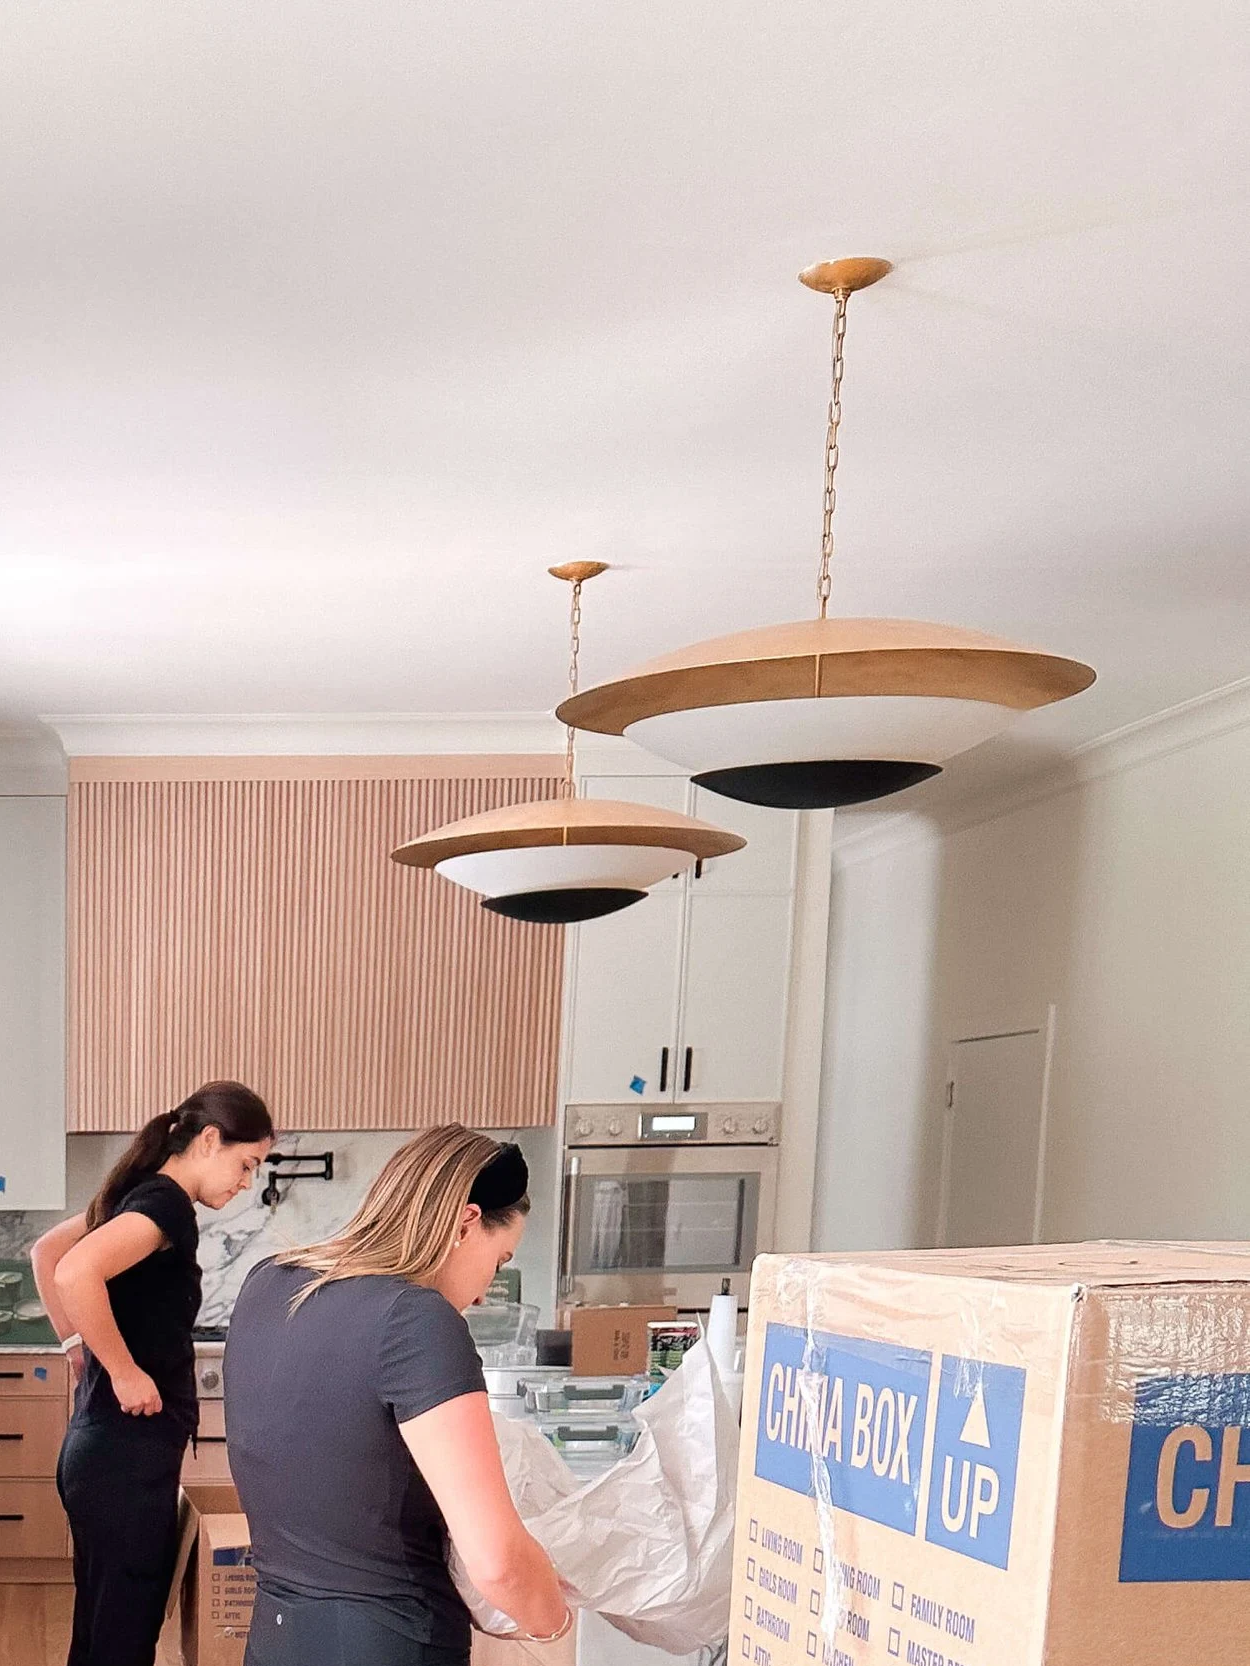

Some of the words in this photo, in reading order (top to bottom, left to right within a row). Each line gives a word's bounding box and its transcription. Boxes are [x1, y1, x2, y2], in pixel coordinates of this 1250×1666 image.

[850, 1382, 919, 1486] BOX
[940, 1455, 1000, 1540] UP
[761, 1527, 783, 1556] LIVING
[783, 1537, 804, 1566] ROOM
[758, 1567, 778, 1594] GIRLS
[778, 1576, 798, 1605] ROOM
[856, 1568, 881, 1601] ROOM
[756, 1605, 790, 1643] BATHROOM
[846, 1610, 870, 1642] ROOM
[910, 1593, 944, 1630] FAMILY
[945, 1608, 975, 1644] ROOM
